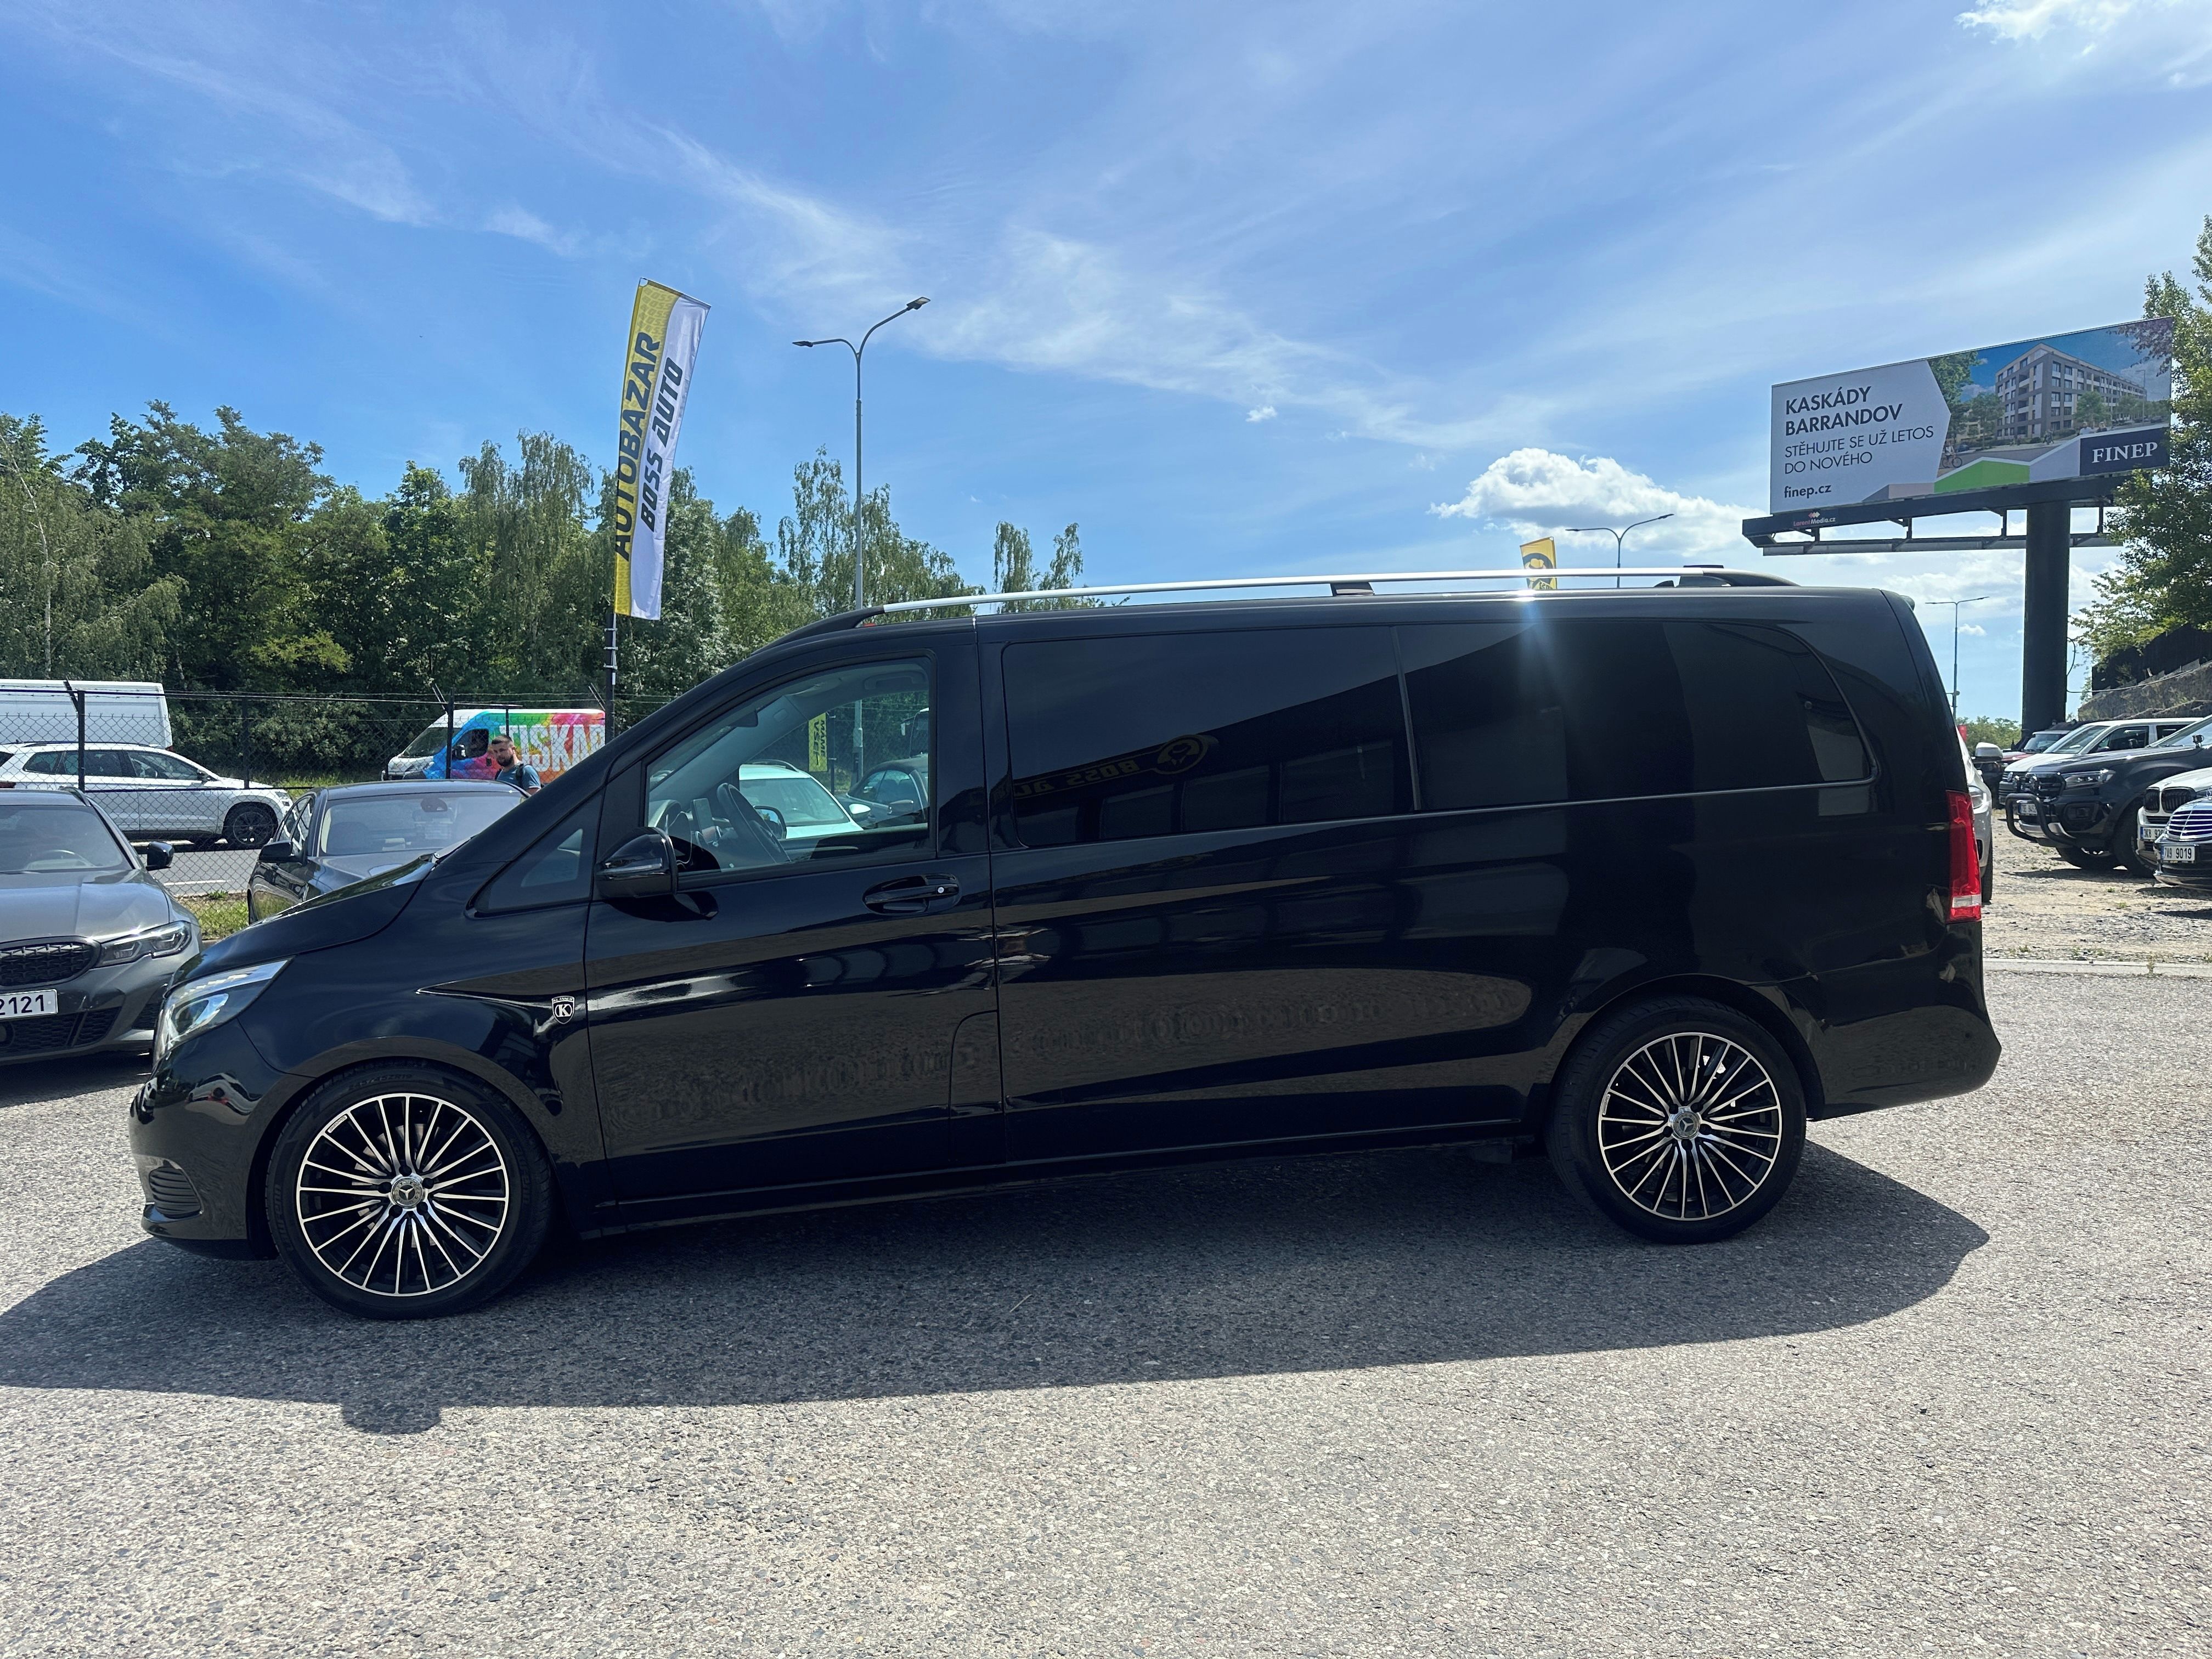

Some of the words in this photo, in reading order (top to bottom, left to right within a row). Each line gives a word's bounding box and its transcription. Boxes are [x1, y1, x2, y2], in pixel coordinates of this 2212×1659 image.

[1786, 386, 1871, 415] KASKÁDY
[1786, 404, 1903, 436] BARRANDOV
[615, 331, 661, 562] AUTOBAZAR
[641, 448, 663, 532] BOSS
[652, 357, 682, 448] AUTO
[1785, 441, 1845, 458] STĚHUJTE
[1849, 435, 1864, 448] SE
[1869, 429, 1887, 445] UŽ
[1892, 426, 1934, 443] LETOS
[2091, 442, 2158, 464] FINEP
[1785, 461, 1805, 475] DO
[1810, 452, 1872, 471] NOVÉHO
[1784, 485, 1832, 499] finep.cz
[2176, 848, 2192, 859] 9019
[0, 994, 44, 1015] 2121
